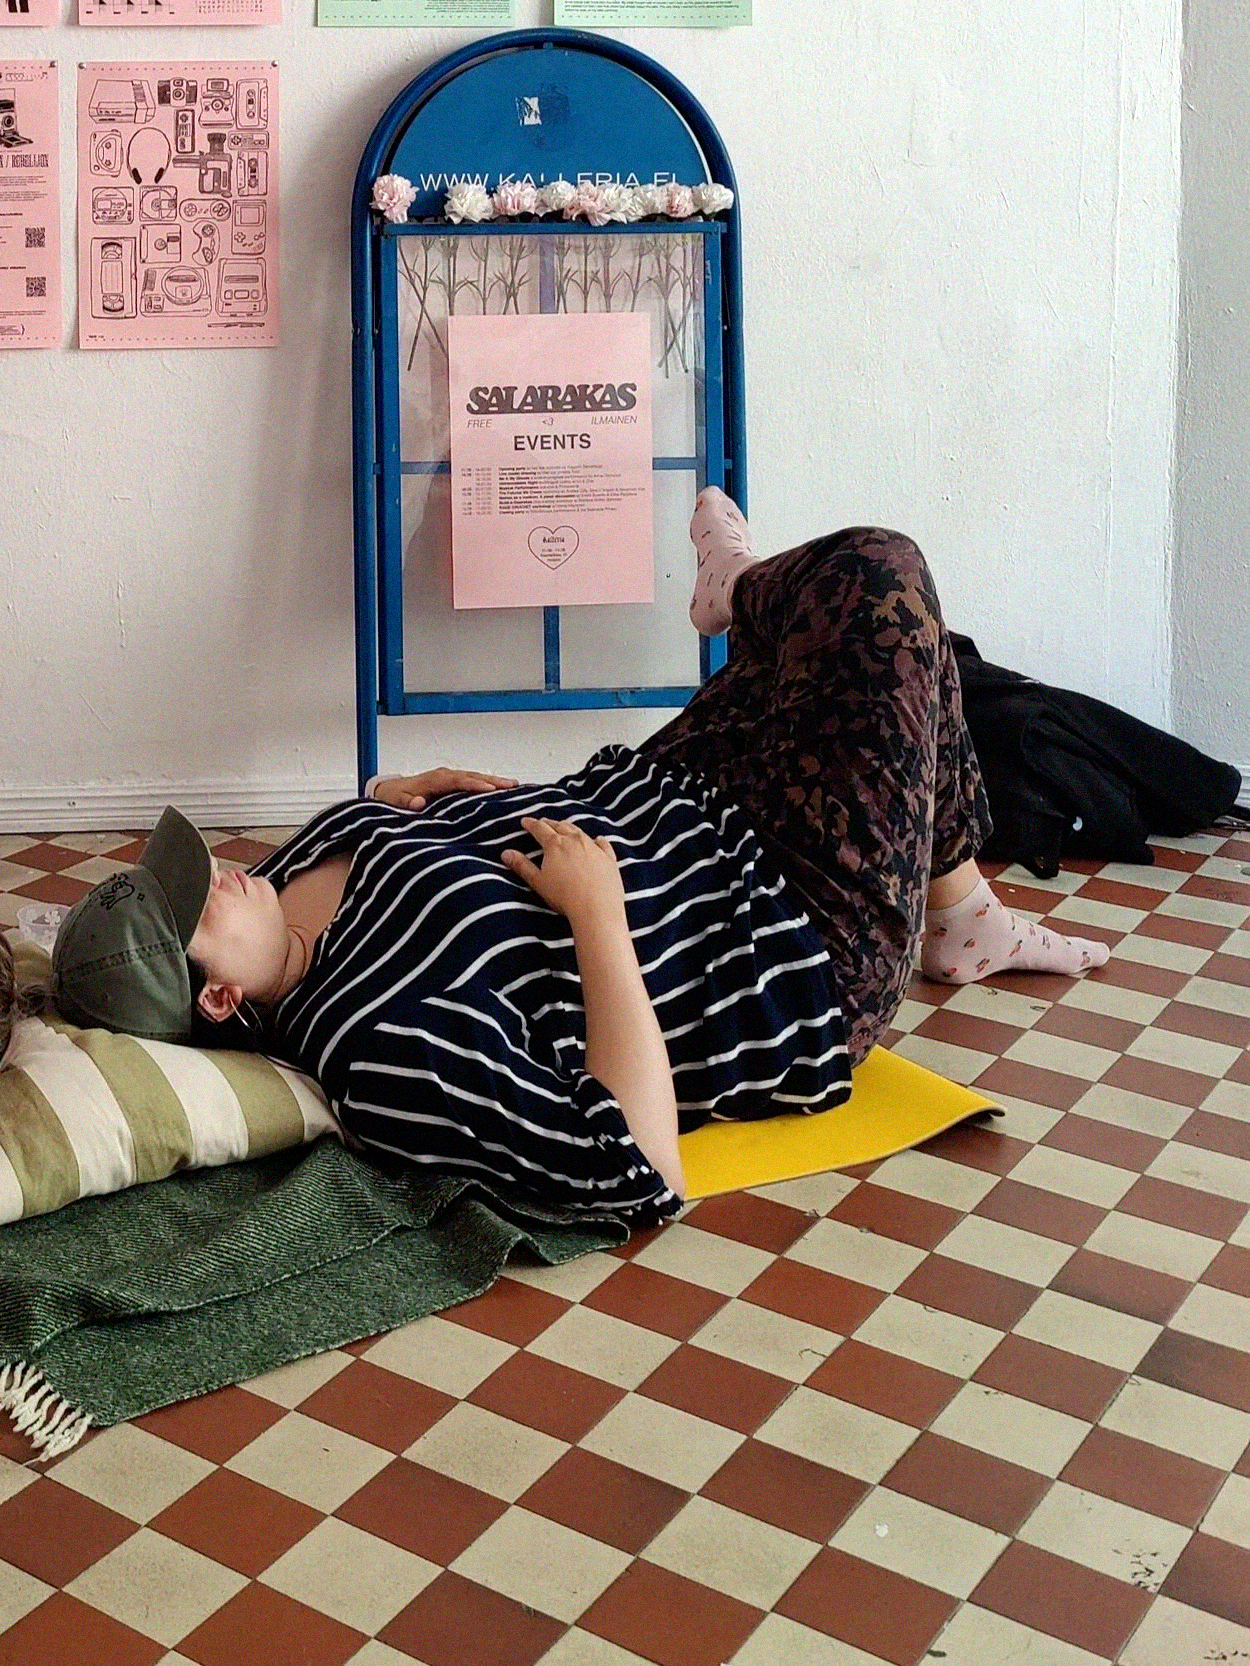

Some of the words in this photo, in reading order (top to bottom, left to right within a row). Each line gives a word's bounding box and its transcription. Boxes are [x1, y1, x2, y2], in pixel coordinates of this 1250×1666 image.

[419, 172, 676, 191] WWW.KAERIAFI
[466, 383, 637, 415] SALARAKAS
[466, 418, 492, 428] FREE
[590, 415, 638, 425] ILMAINEN
[513, 433, 591, 451] EVENTS
